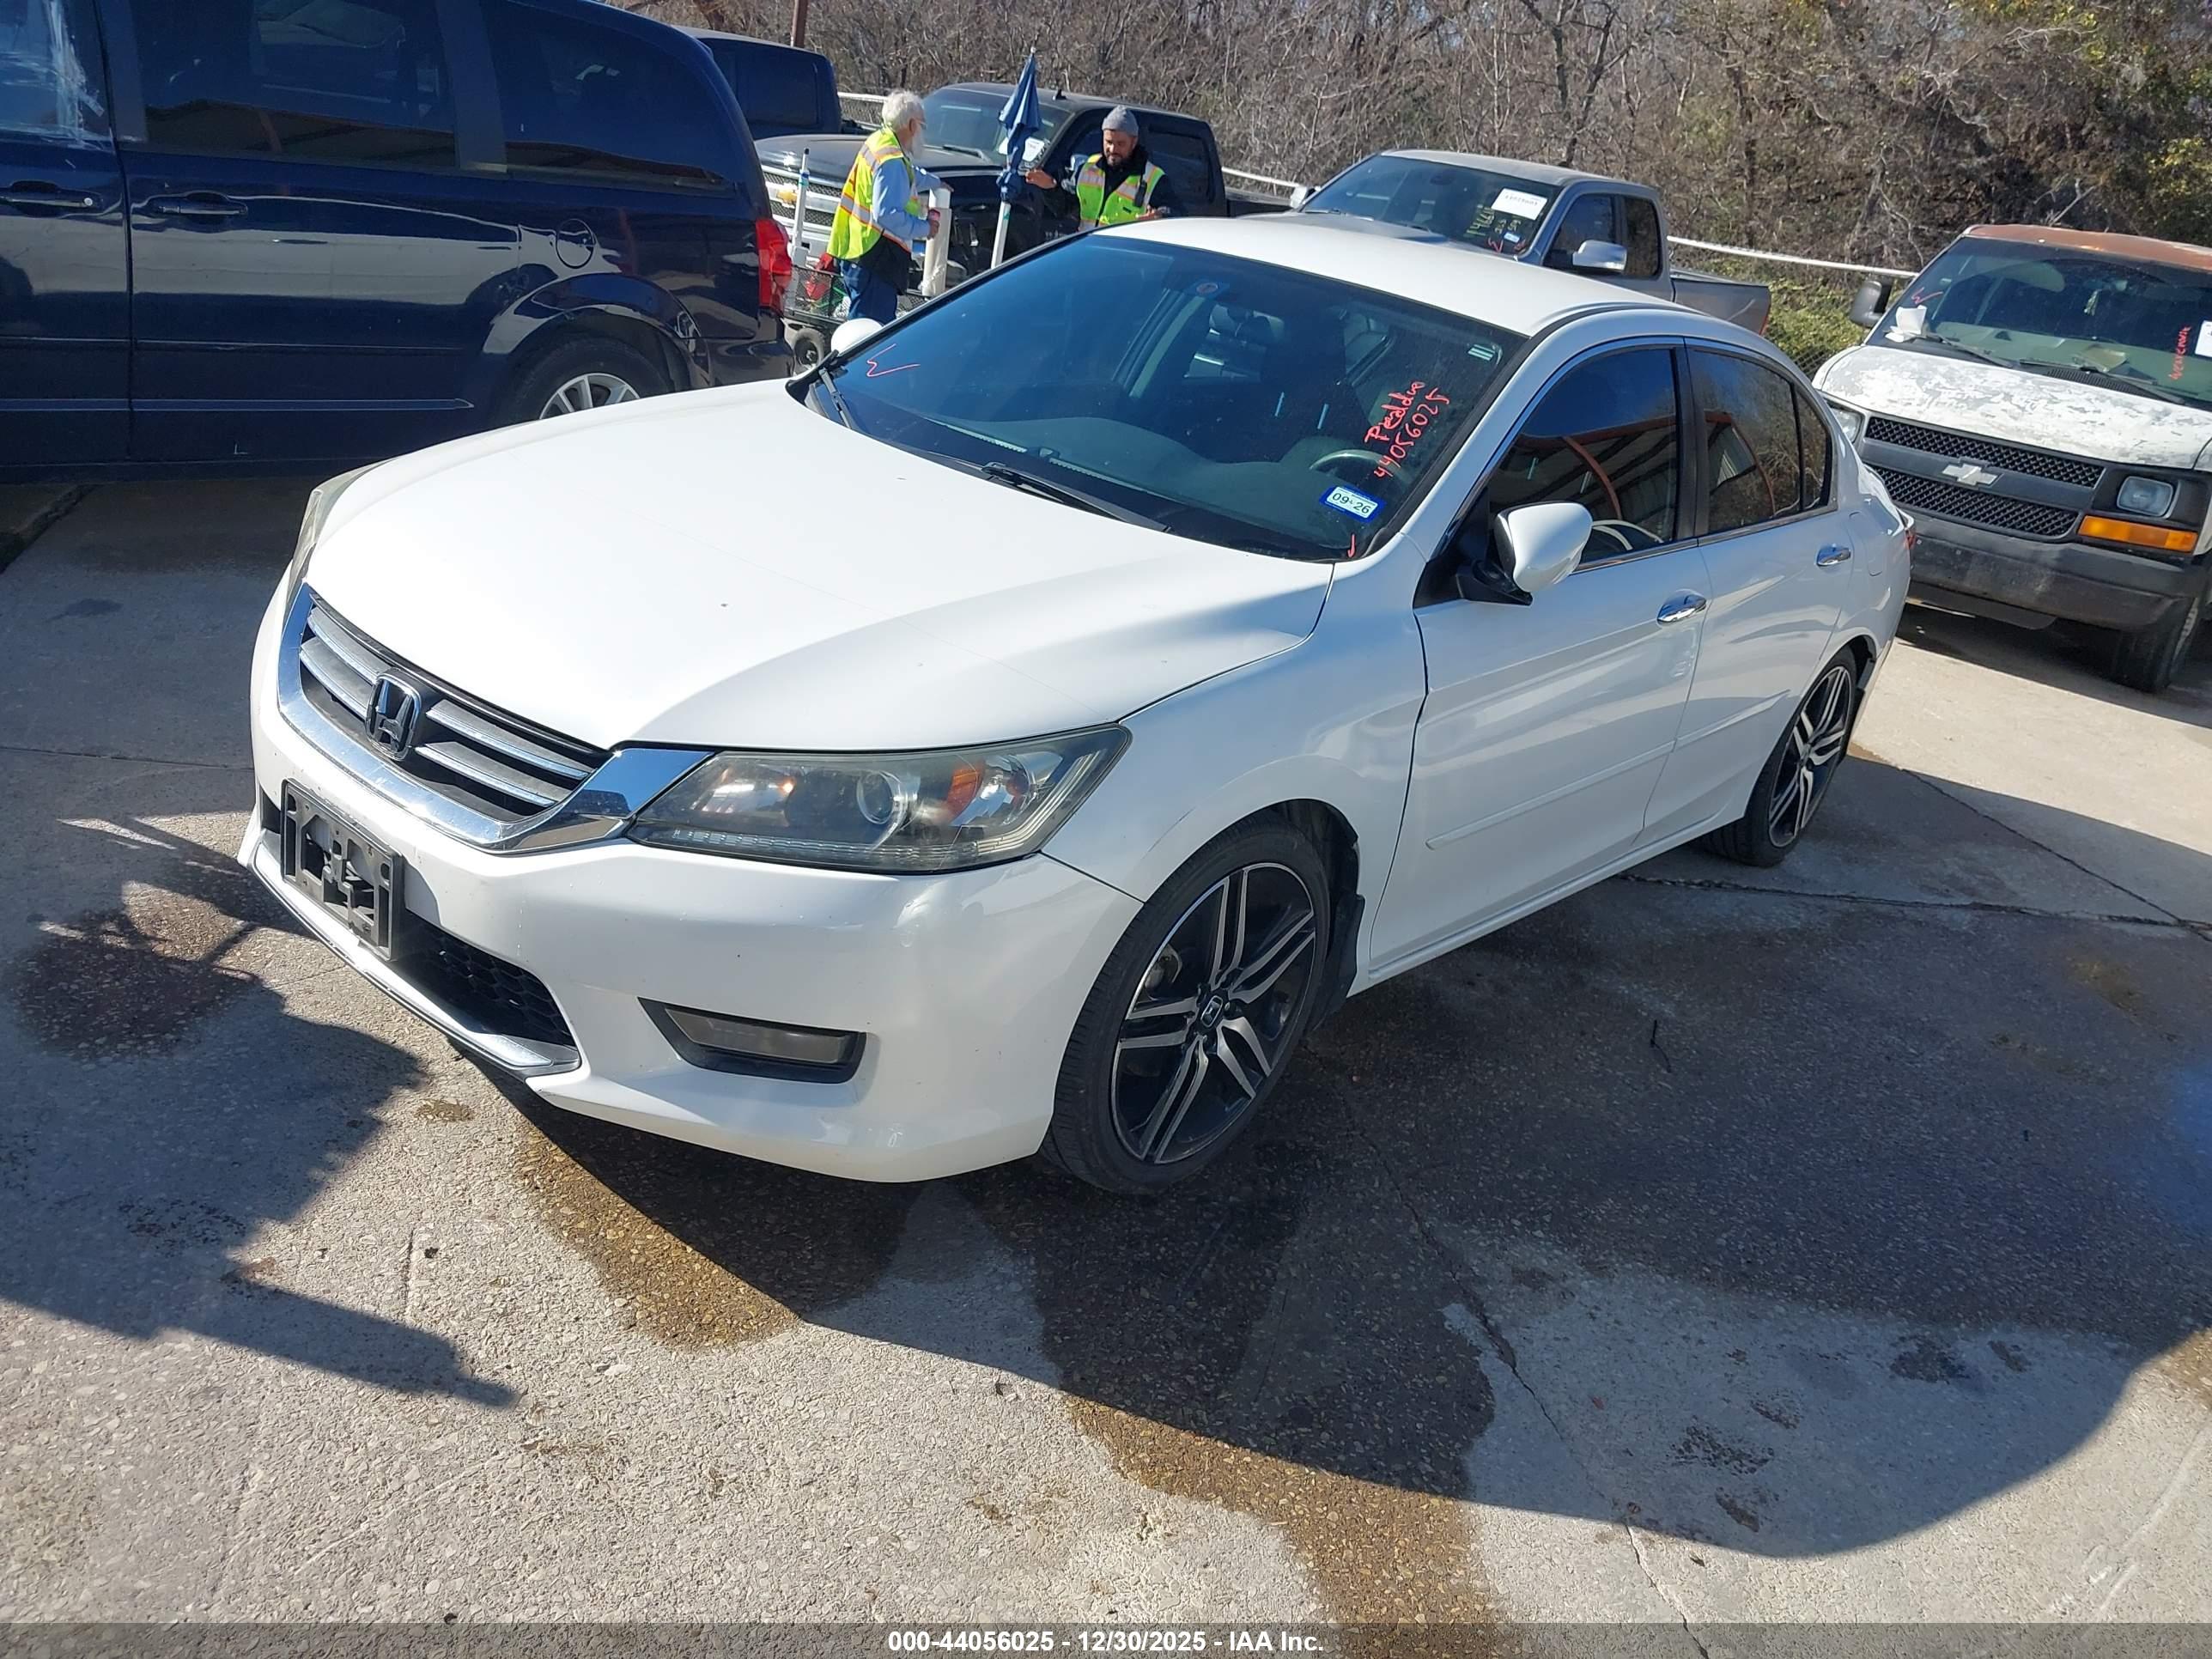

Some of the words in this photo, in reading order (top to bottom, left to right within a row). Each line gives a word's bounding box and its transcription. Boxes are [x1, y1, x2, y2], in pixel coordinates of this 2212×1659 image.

[1373, 387, 1450, 477] 44056025
[1332, 492, 1350, 505] 09
[1353, 501, 1371, 514] 26
